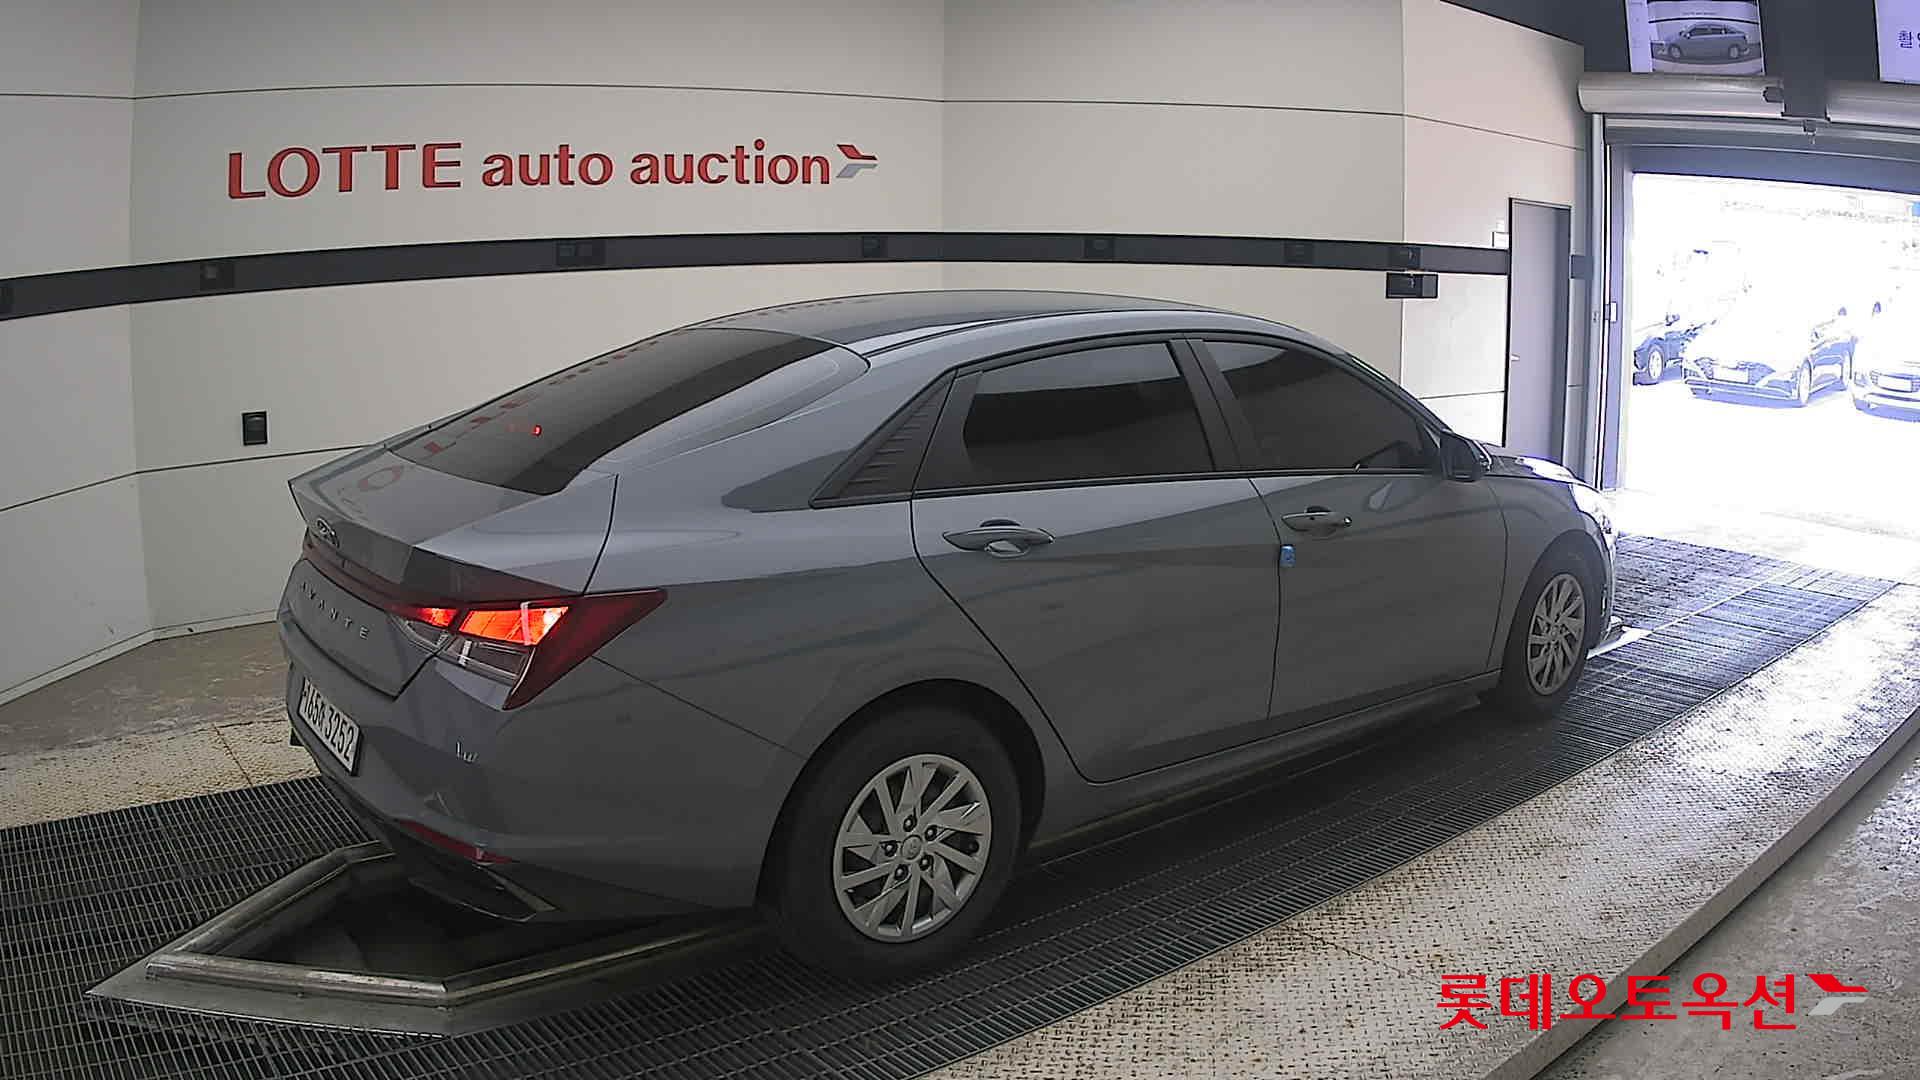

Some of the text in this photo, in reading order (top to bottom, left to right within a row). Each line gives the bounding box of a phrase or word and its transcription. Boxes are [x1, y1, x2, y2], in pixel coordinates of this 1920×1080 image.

[228, 139, 831, 199] LOTTE auto auction
[325, 704, 354, 762] 3252
